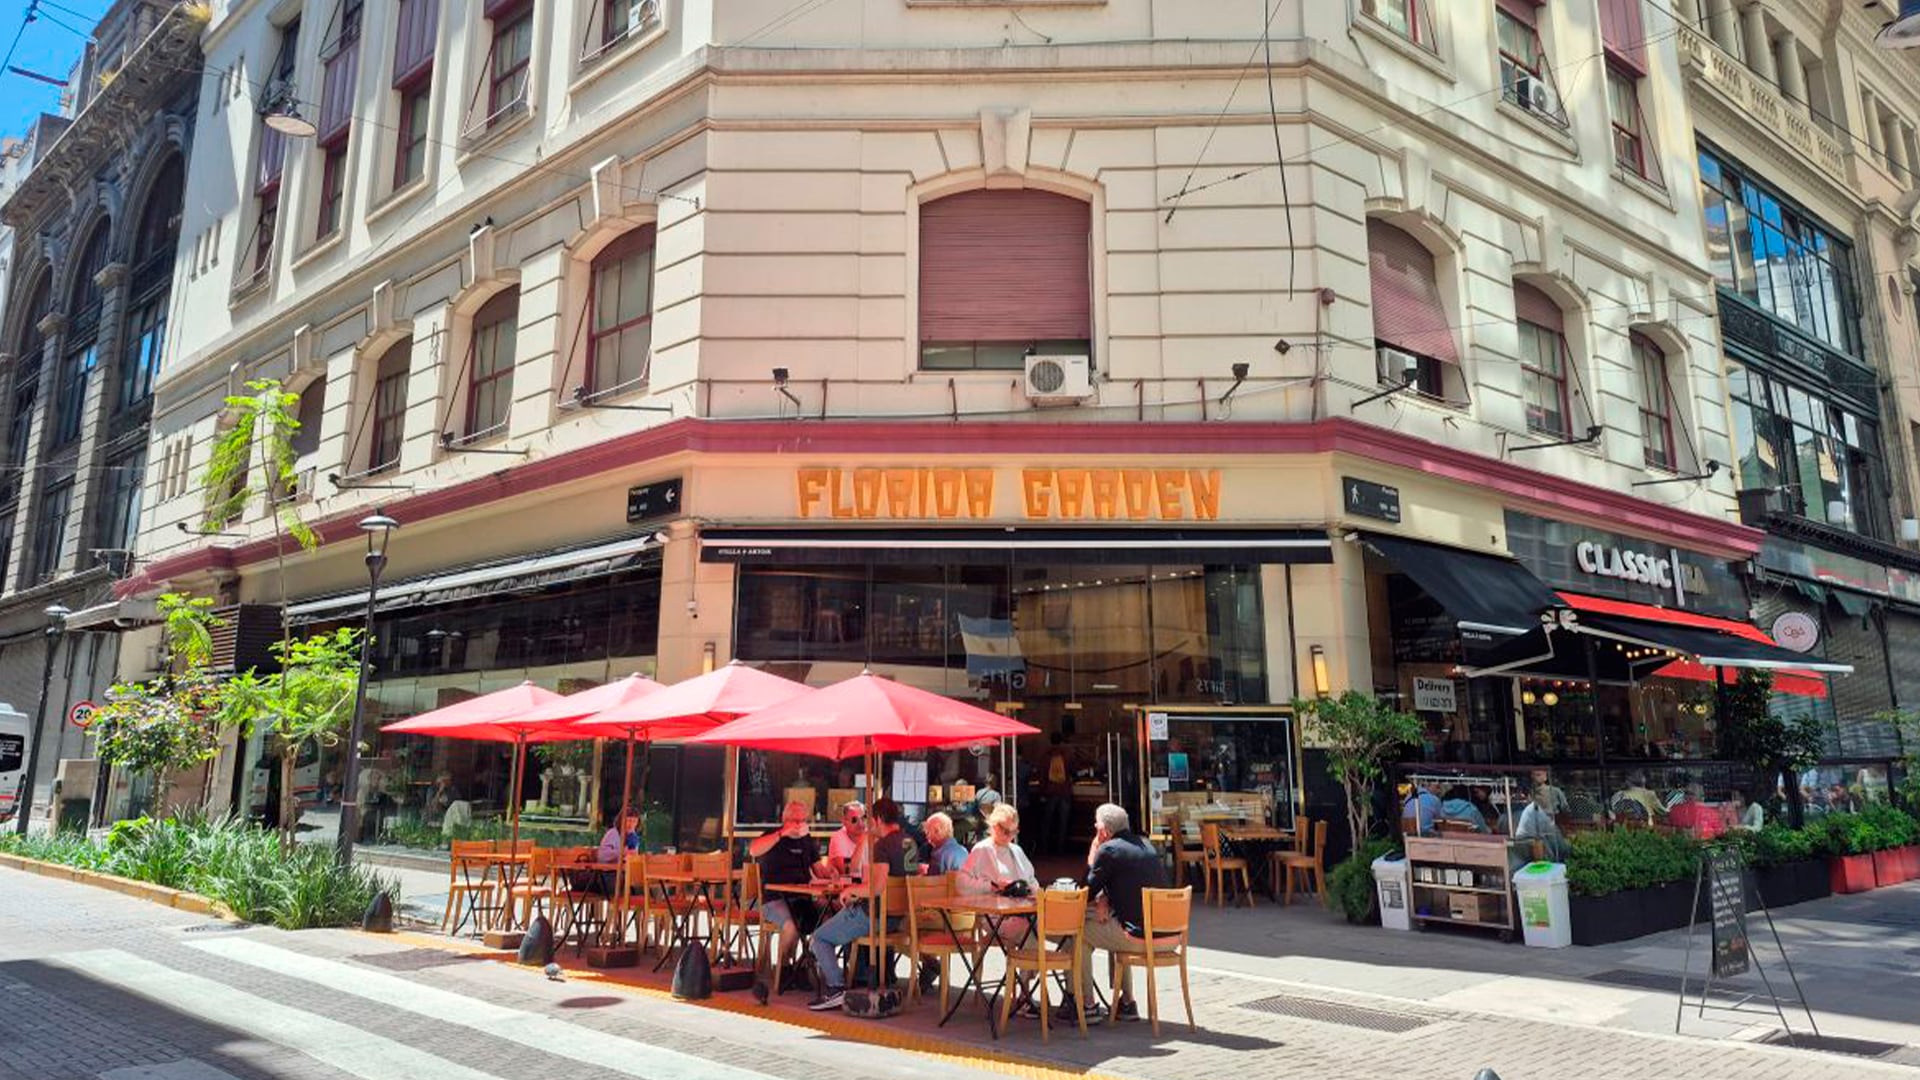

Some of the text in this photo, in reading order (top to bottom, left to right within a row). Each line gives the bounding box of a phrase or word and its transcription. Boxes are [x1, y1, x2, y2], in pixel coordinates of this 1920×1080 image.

[797, 469, 1222, 519] FLORIDA GARDEN
[1577, 541, 1672, 588] CLASSIC
[1417, 678, 1451, 694] Delivery
[75, 708, 92, 720] 20
